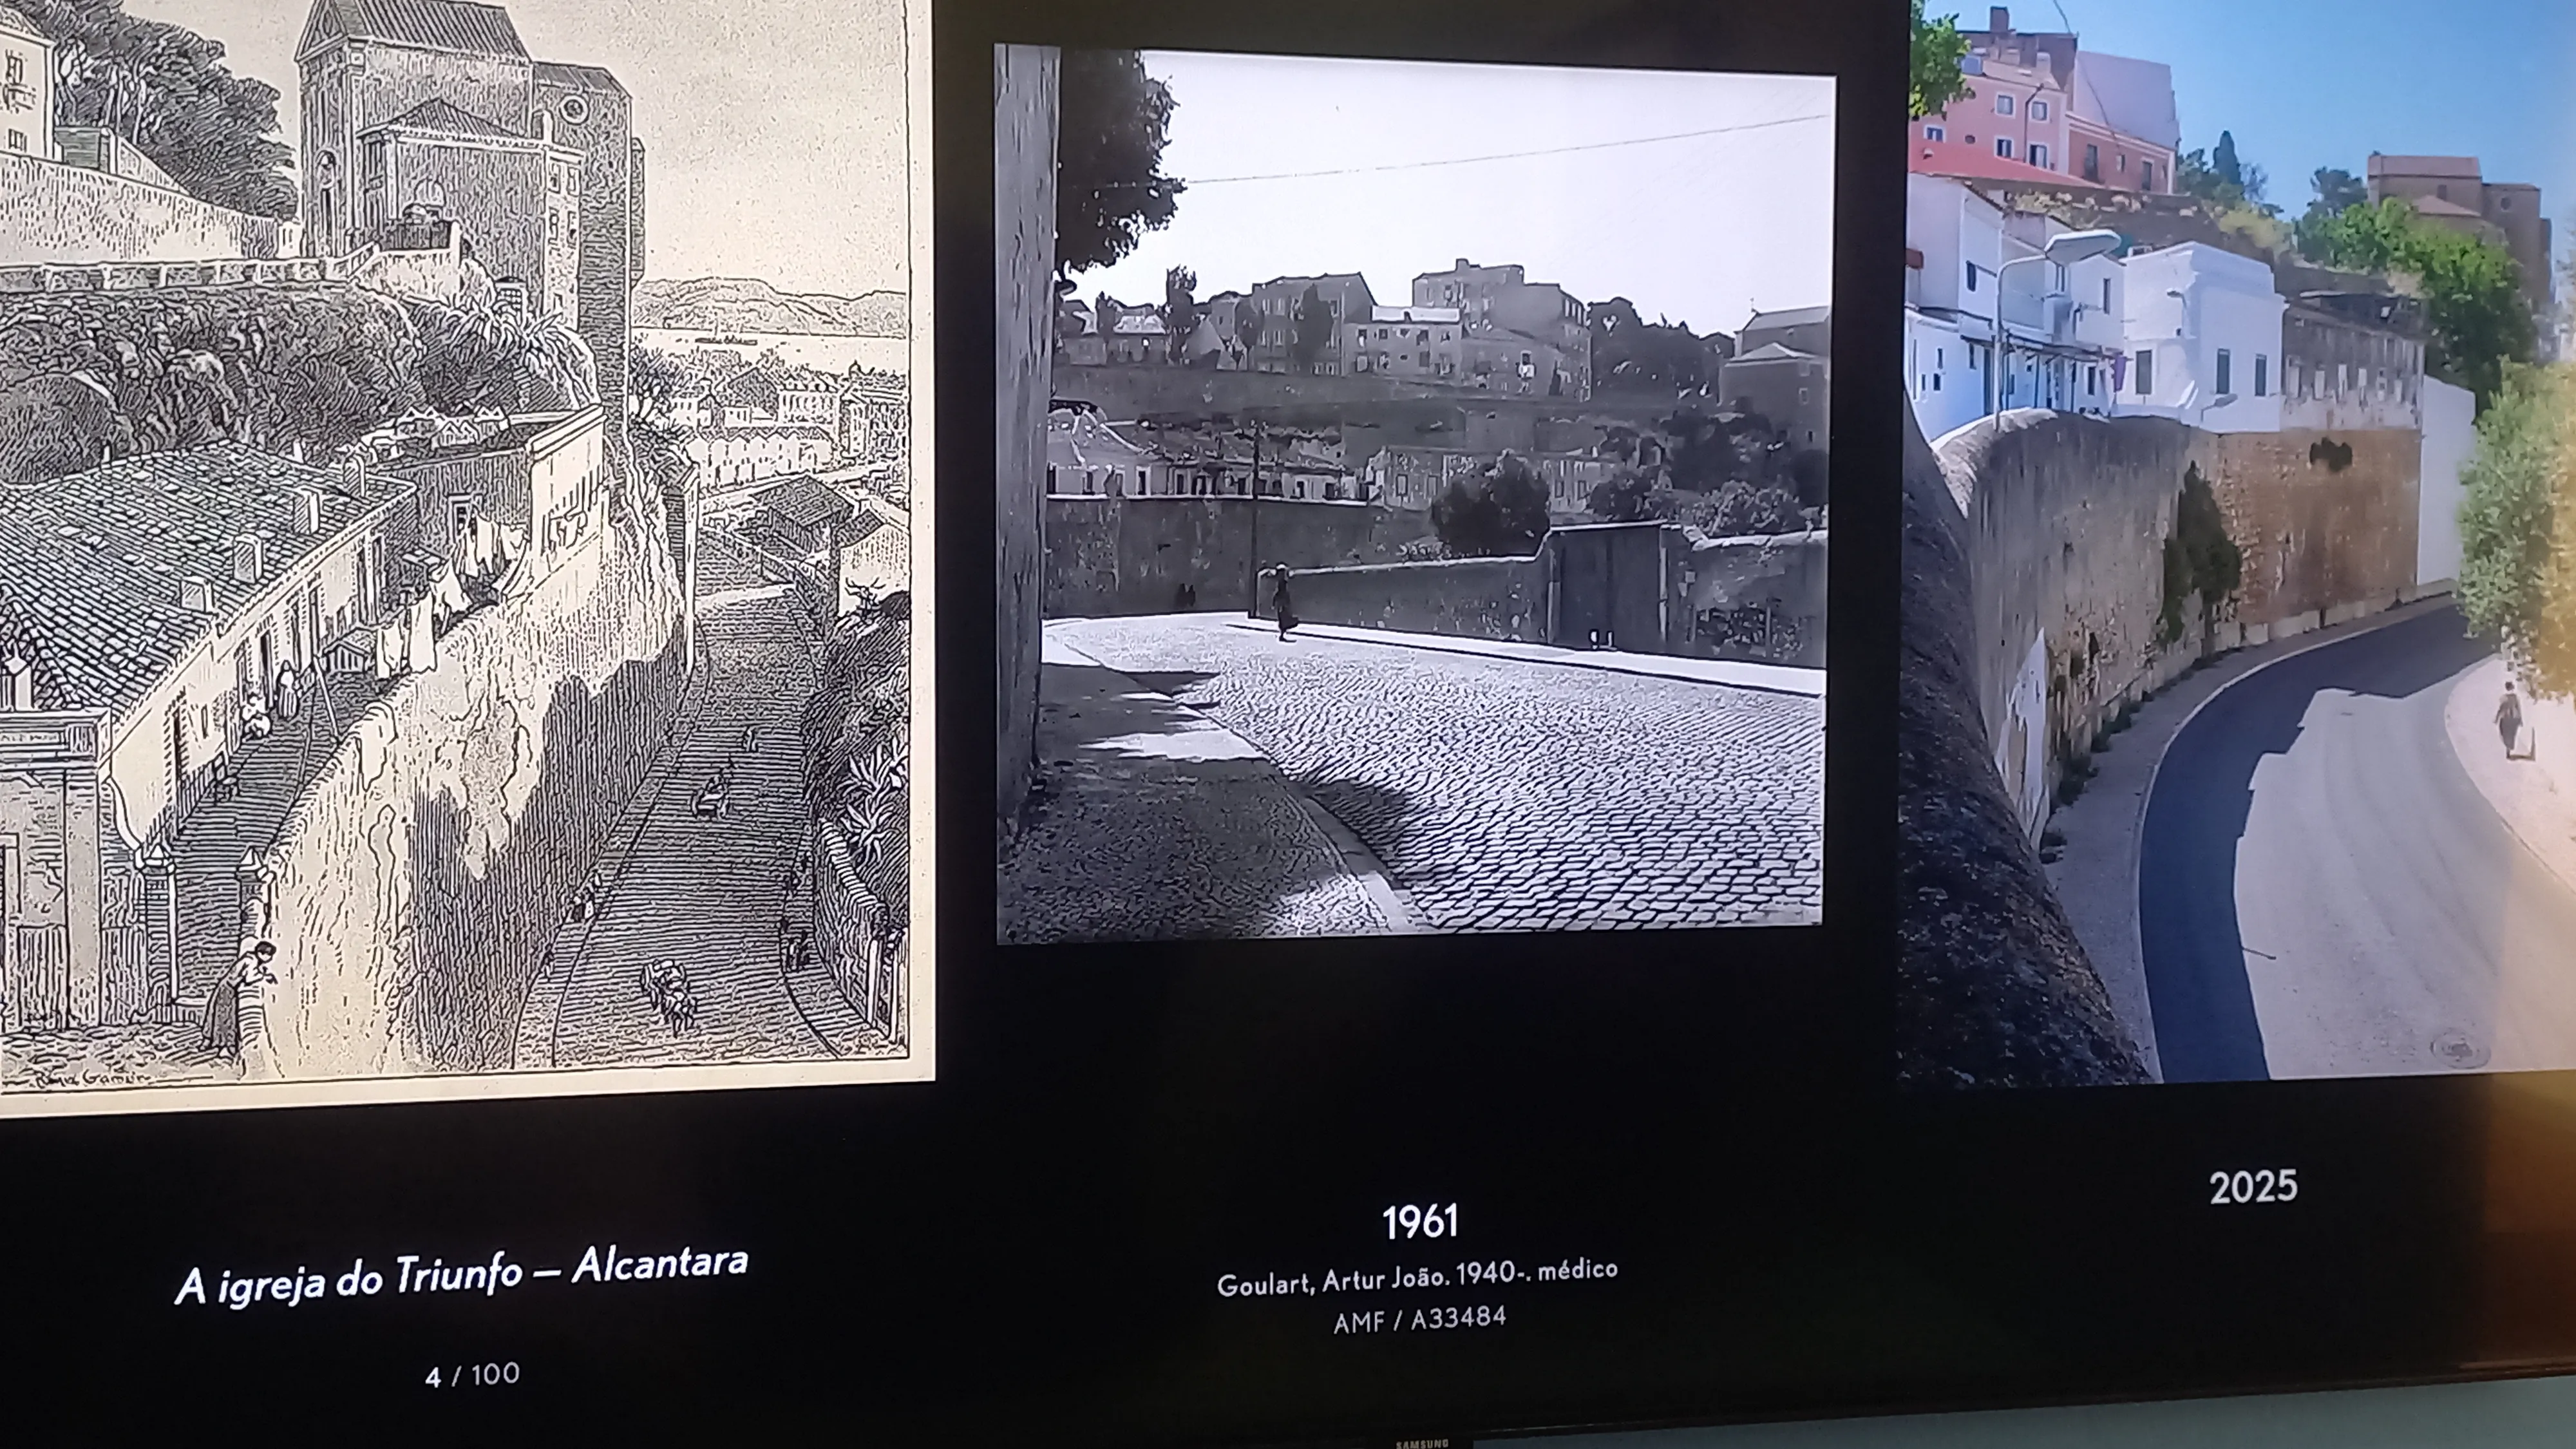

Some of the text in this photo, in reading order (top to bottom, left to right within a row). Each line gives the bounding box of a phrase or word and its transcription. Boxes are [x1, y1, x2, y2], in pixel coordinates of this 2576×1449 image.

[2210, 1169, 2298, 1204] 2025
[1383, 1202, 1457, 1240] 1961
[173, 1267, 206, 1305] A
[218, 1266, 326, 1311] igreja
[336, 1258, 383, 1296] do
[397, 1250, 523, 1296] Triunfo
[571, 1244, 749, 1283] Alcantara
[1217, 1256, 1618, 1297] Goulart, Artur João. 1940-. médico
[1334, 1305, 1506, 1334] AMF / A33484
[425, 1361, 520, 1388] 4 / 100
[1396, 1439, 1449, 1449] SAMSUNG
